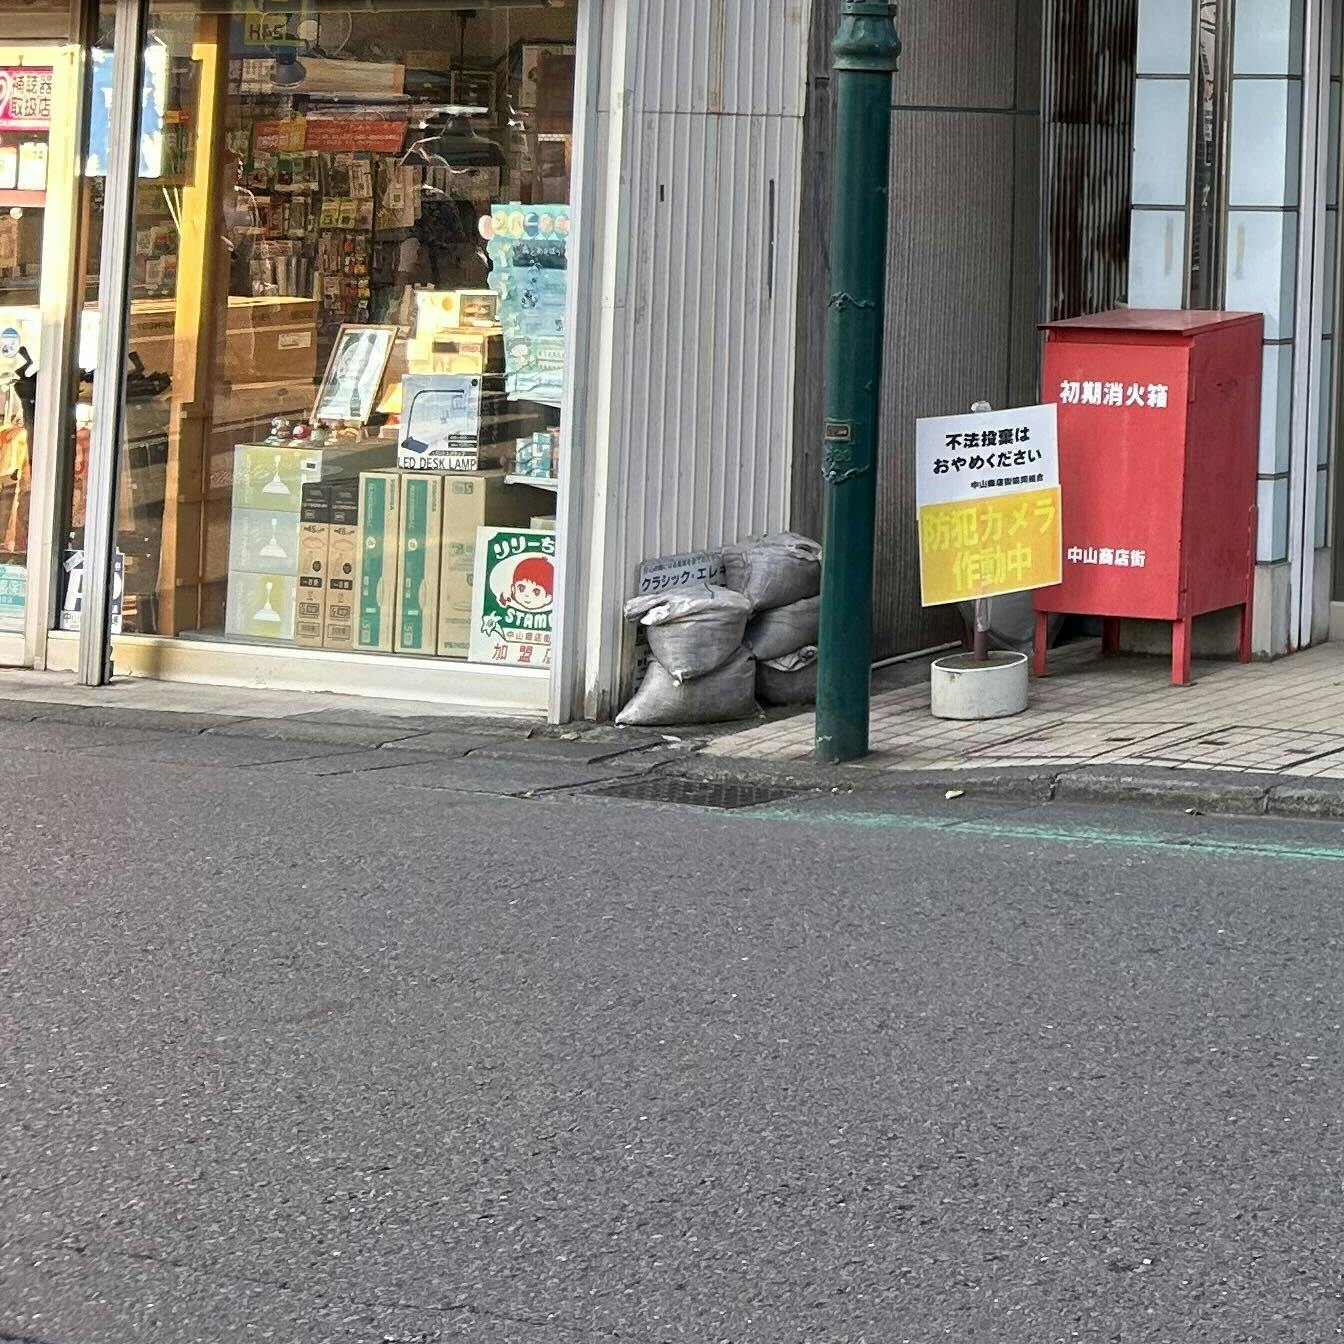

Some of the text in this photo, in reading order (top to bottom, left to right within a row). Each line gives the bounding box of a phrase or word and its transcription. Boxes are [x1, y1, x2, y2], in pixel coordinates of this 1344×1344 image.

[1059, 379, 1169, 409] 初期消火箱
[945, 426, 1031, 451] 不法投棄は
[419, 457, 446, 470] DESK
[448, 458, 478, 471] LAMP
[932, 448, 1043, 476] おやめください
[922, 498, 1057, 553] 防犯カメラ
[952, 542, 1033, 592] 作動中
[1067, 546, 1147, 568] 中山商店街
